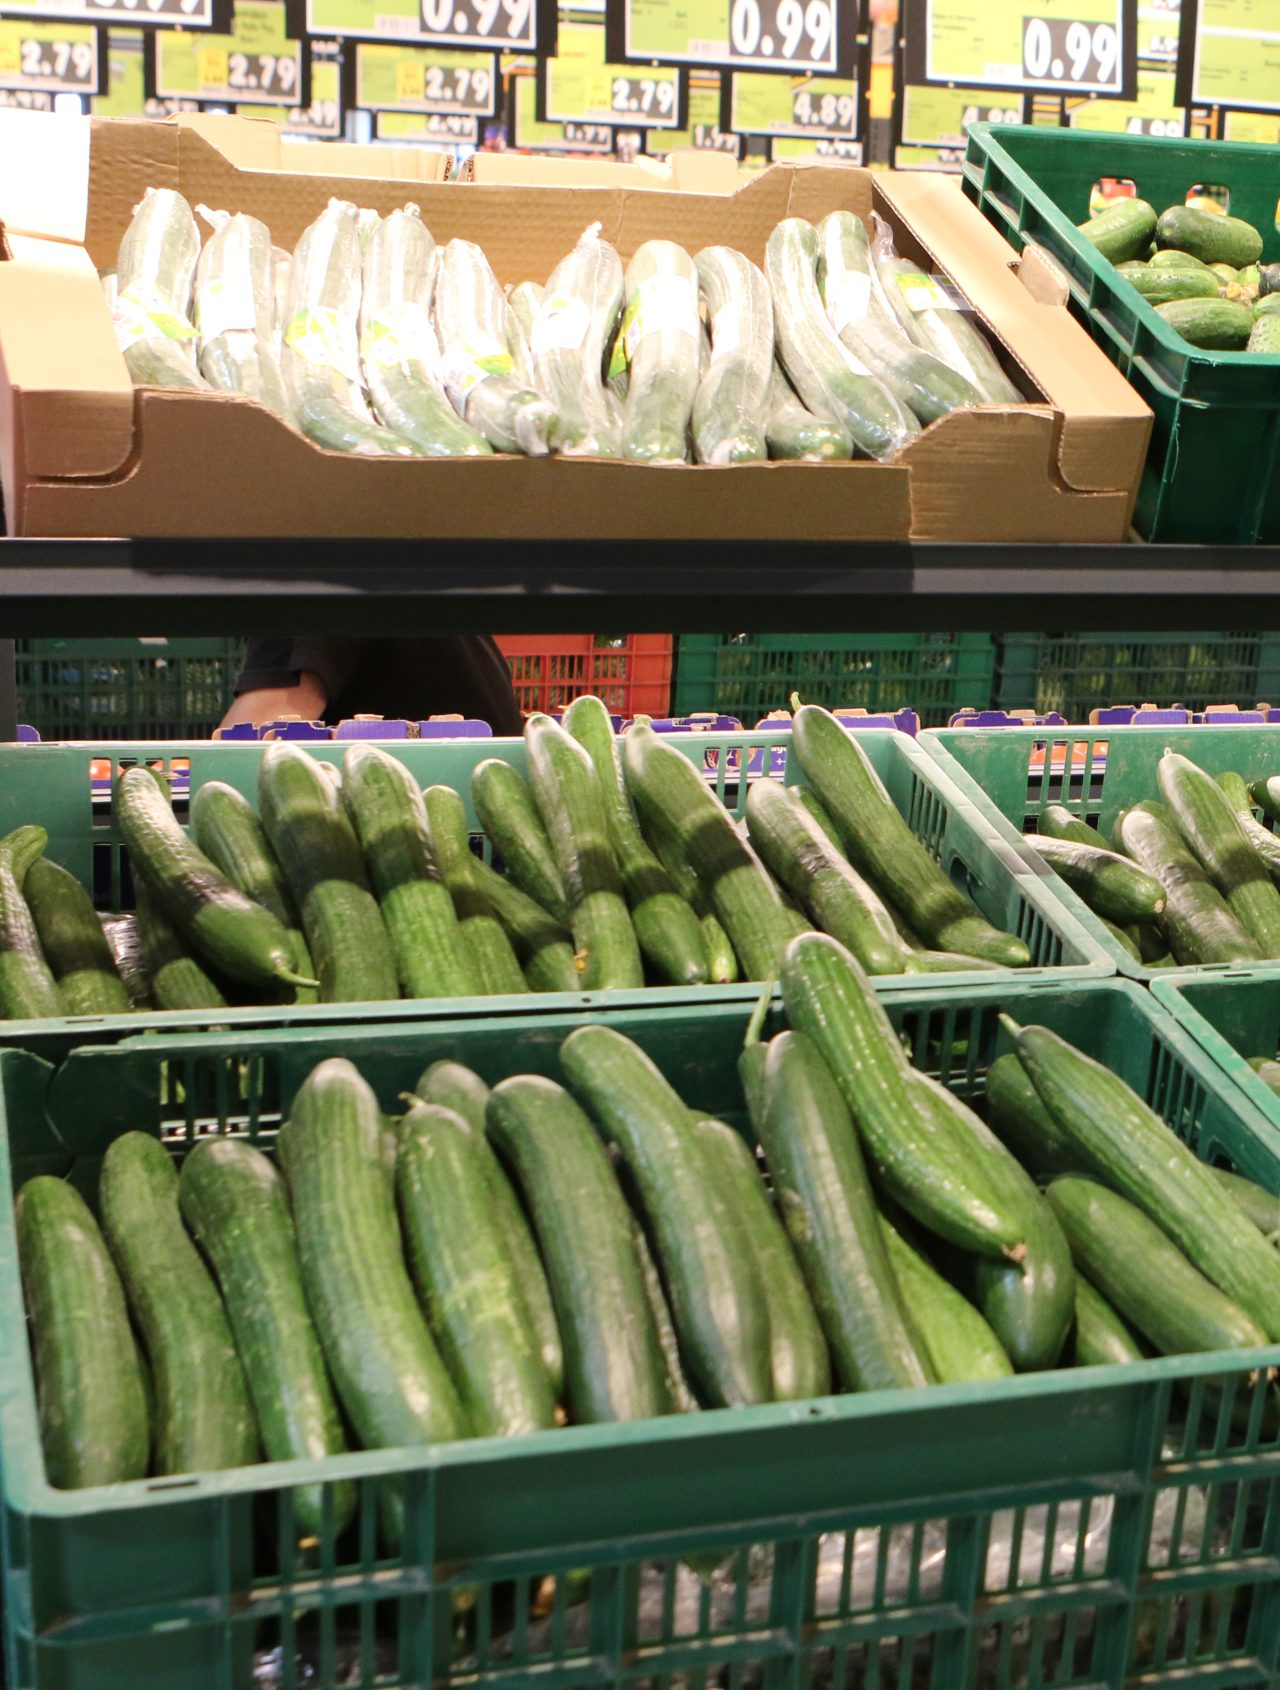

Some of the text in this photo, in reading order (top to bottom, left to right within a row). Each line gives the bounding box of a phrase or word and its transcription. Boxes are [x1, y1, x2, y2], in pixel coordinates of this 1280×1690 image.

[731, 0, 832, 60] 0.99
[21, 38, 92, 79] 2.79
[1023, 17, 1117, 83] 0.99
[228, 53, 296, 91] 2.79
[426, 66, 490, 103] 2.79
[612, 77, 674, 114] 2.79
[793, 91, 852, 127] 4.89
